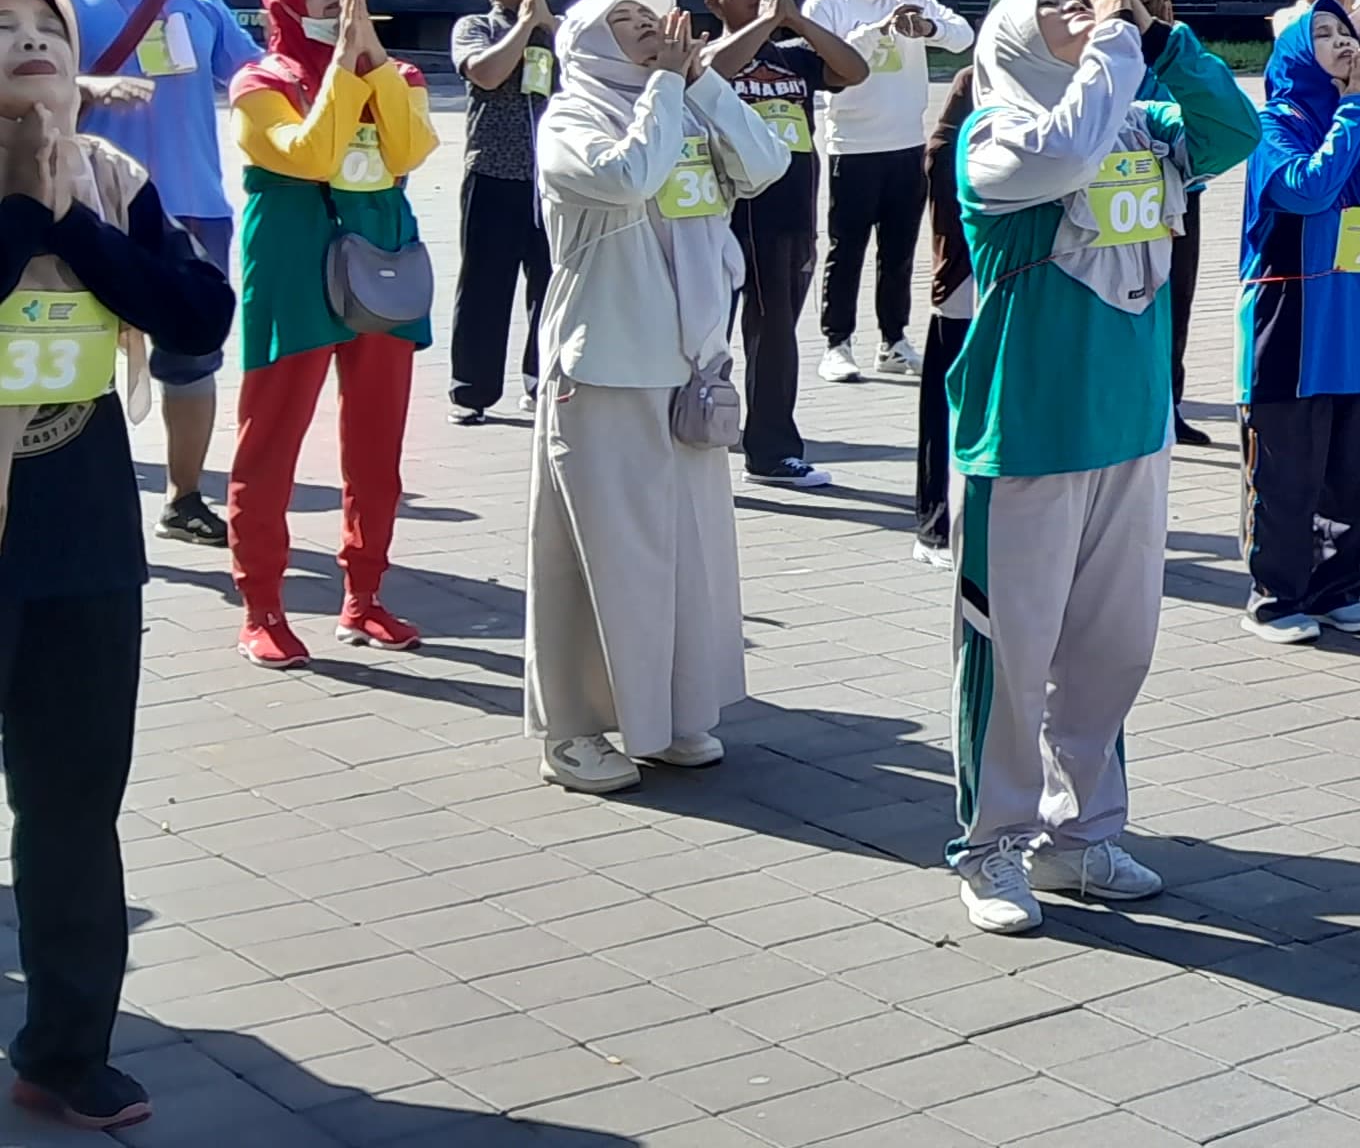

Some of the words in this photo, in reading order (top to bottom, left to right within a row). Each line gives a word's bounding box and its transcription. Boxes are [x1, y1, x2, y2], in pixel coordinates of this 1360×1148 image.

[674, 170, 718, 208] 36
[1109, 186, 1161, 234] 06
[1, 339, 81, 391] 33
[22, 427, 59, 447] EAST
[63, 404, 86, 432] JAA
